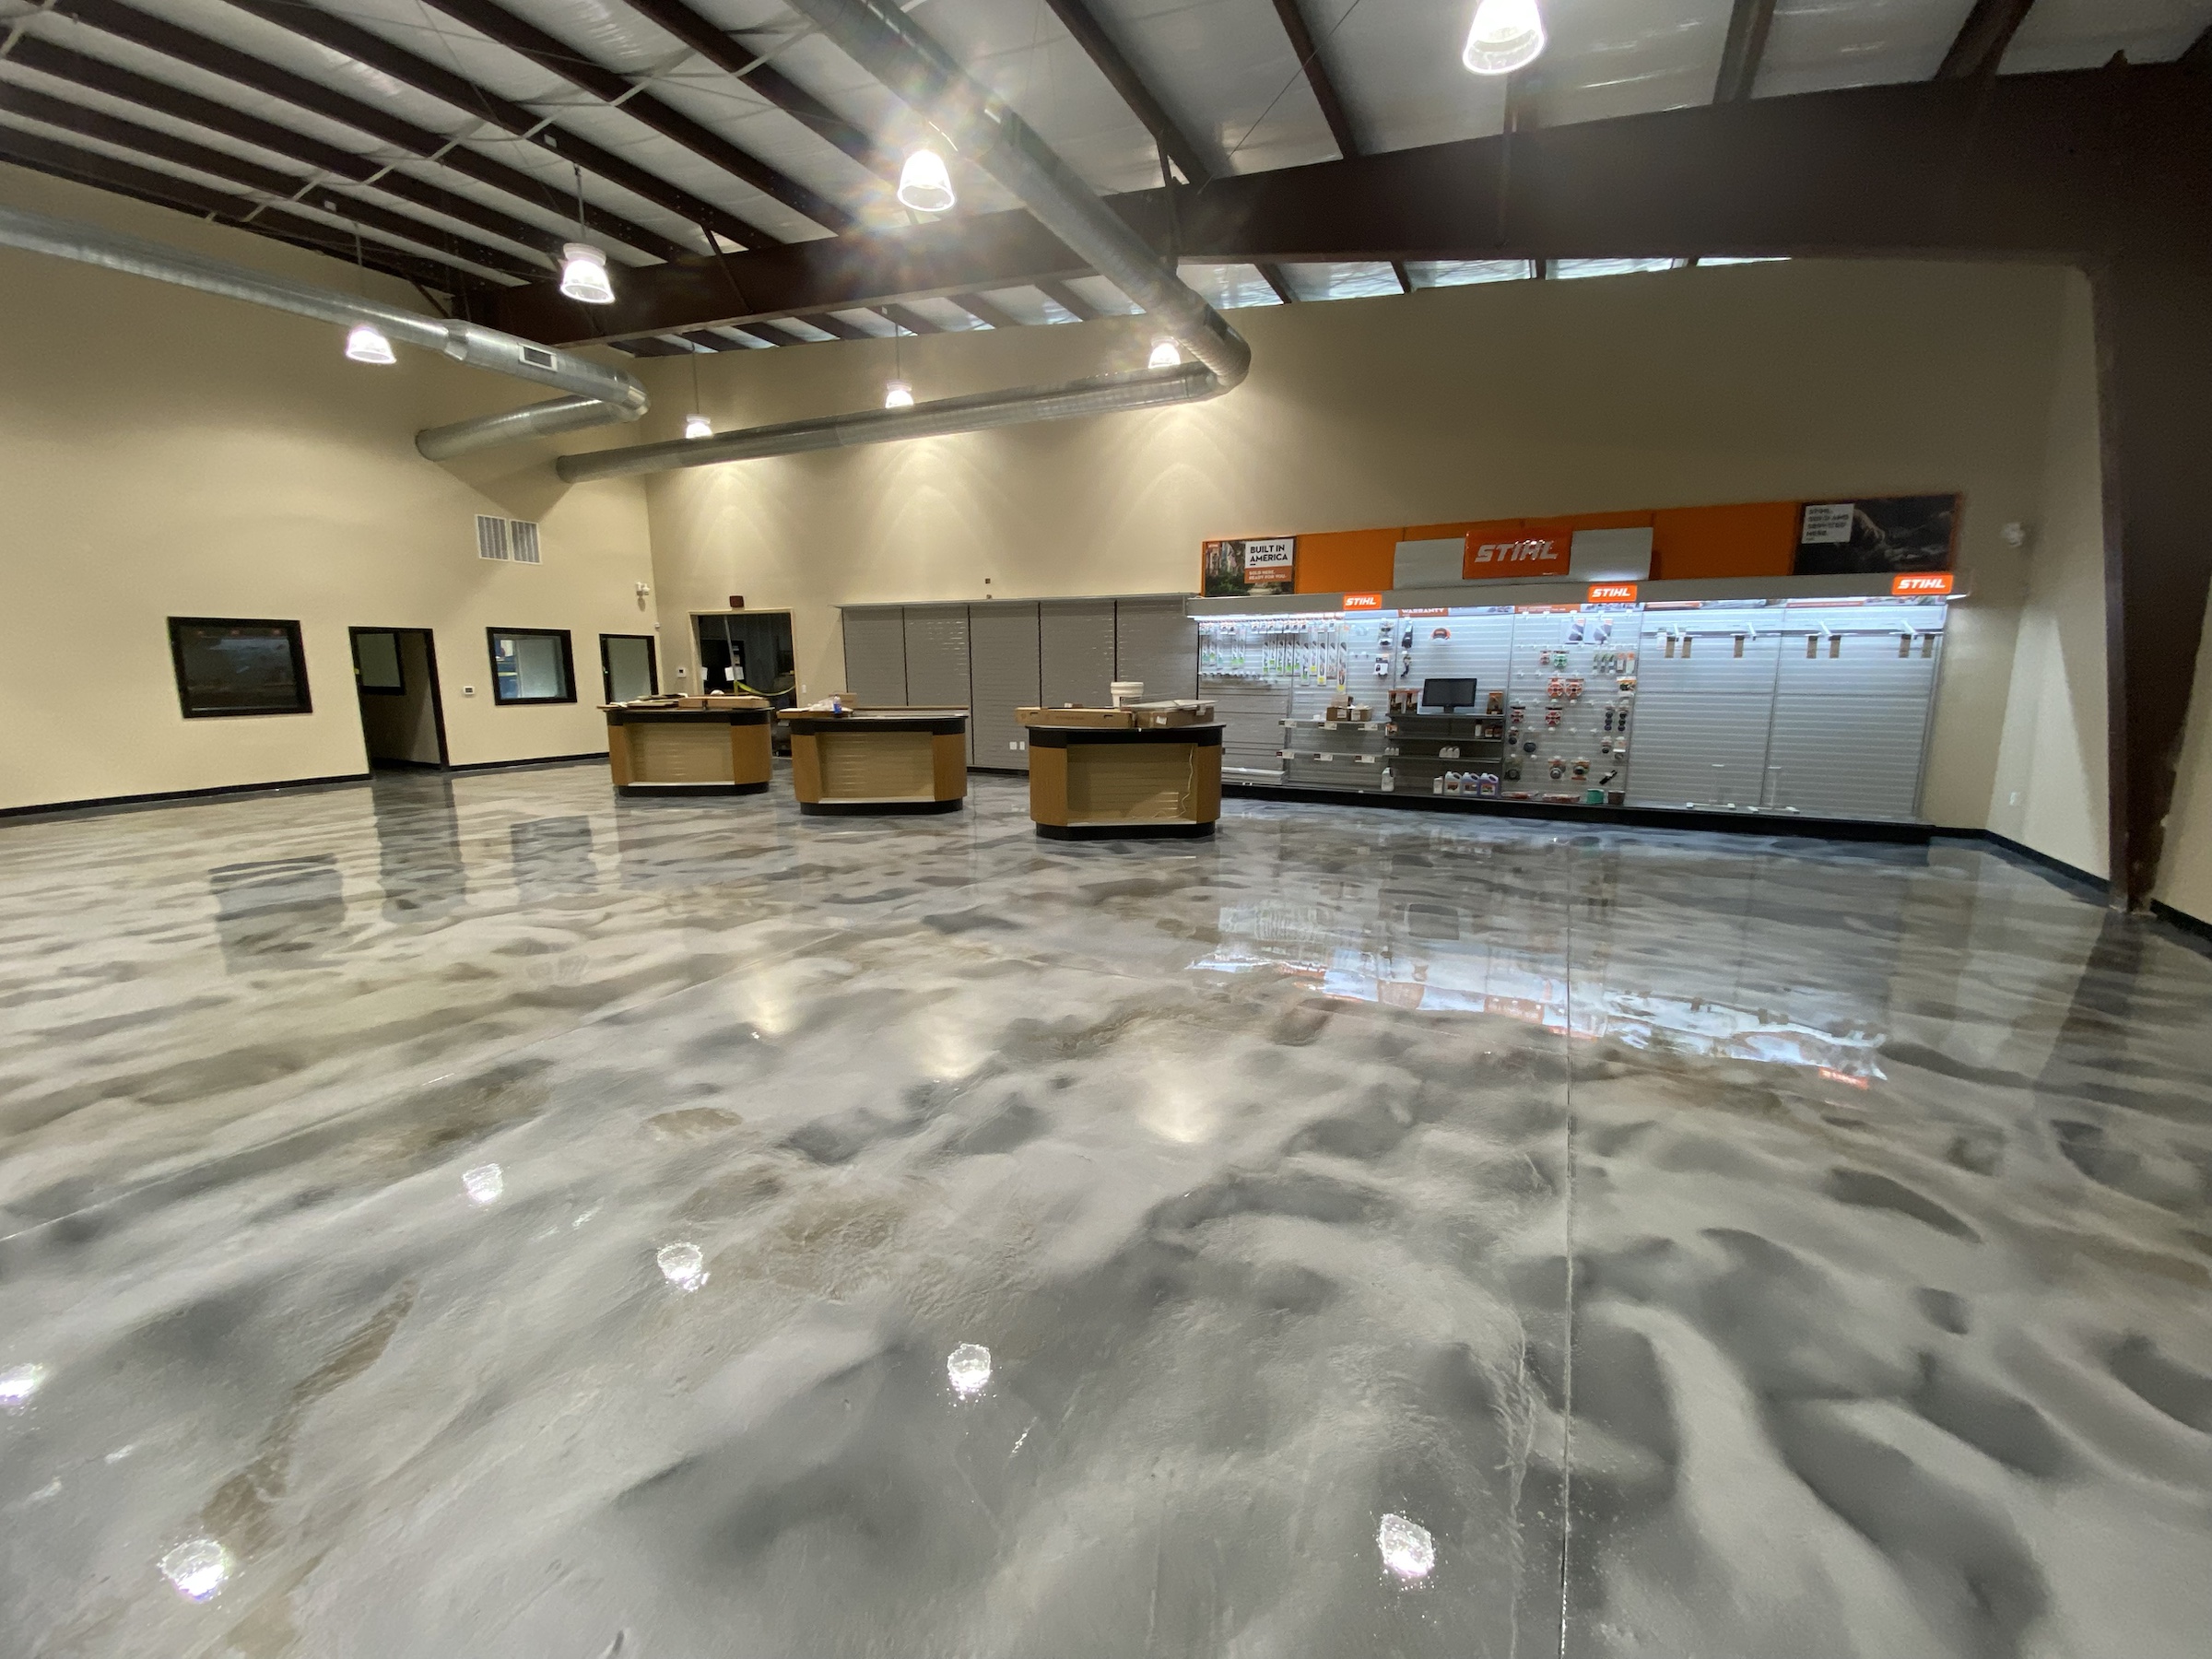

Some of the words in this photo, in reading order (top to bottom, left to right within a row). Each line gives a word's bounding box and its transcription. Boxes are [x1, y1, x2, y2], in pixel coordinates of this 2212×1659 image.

[1250, 545, 1274, 553] BUILT
[1276, 544, 1285, 552] IN
[1475, 539, 1559, 563] STIHL
[1250, 553, 1288, 562] AMERICA
[1898, 578, 1946, 589] STIHL
[1592, 587, 1631, 598] STIHL
[1346, 596, 1377, 606] STIHL
